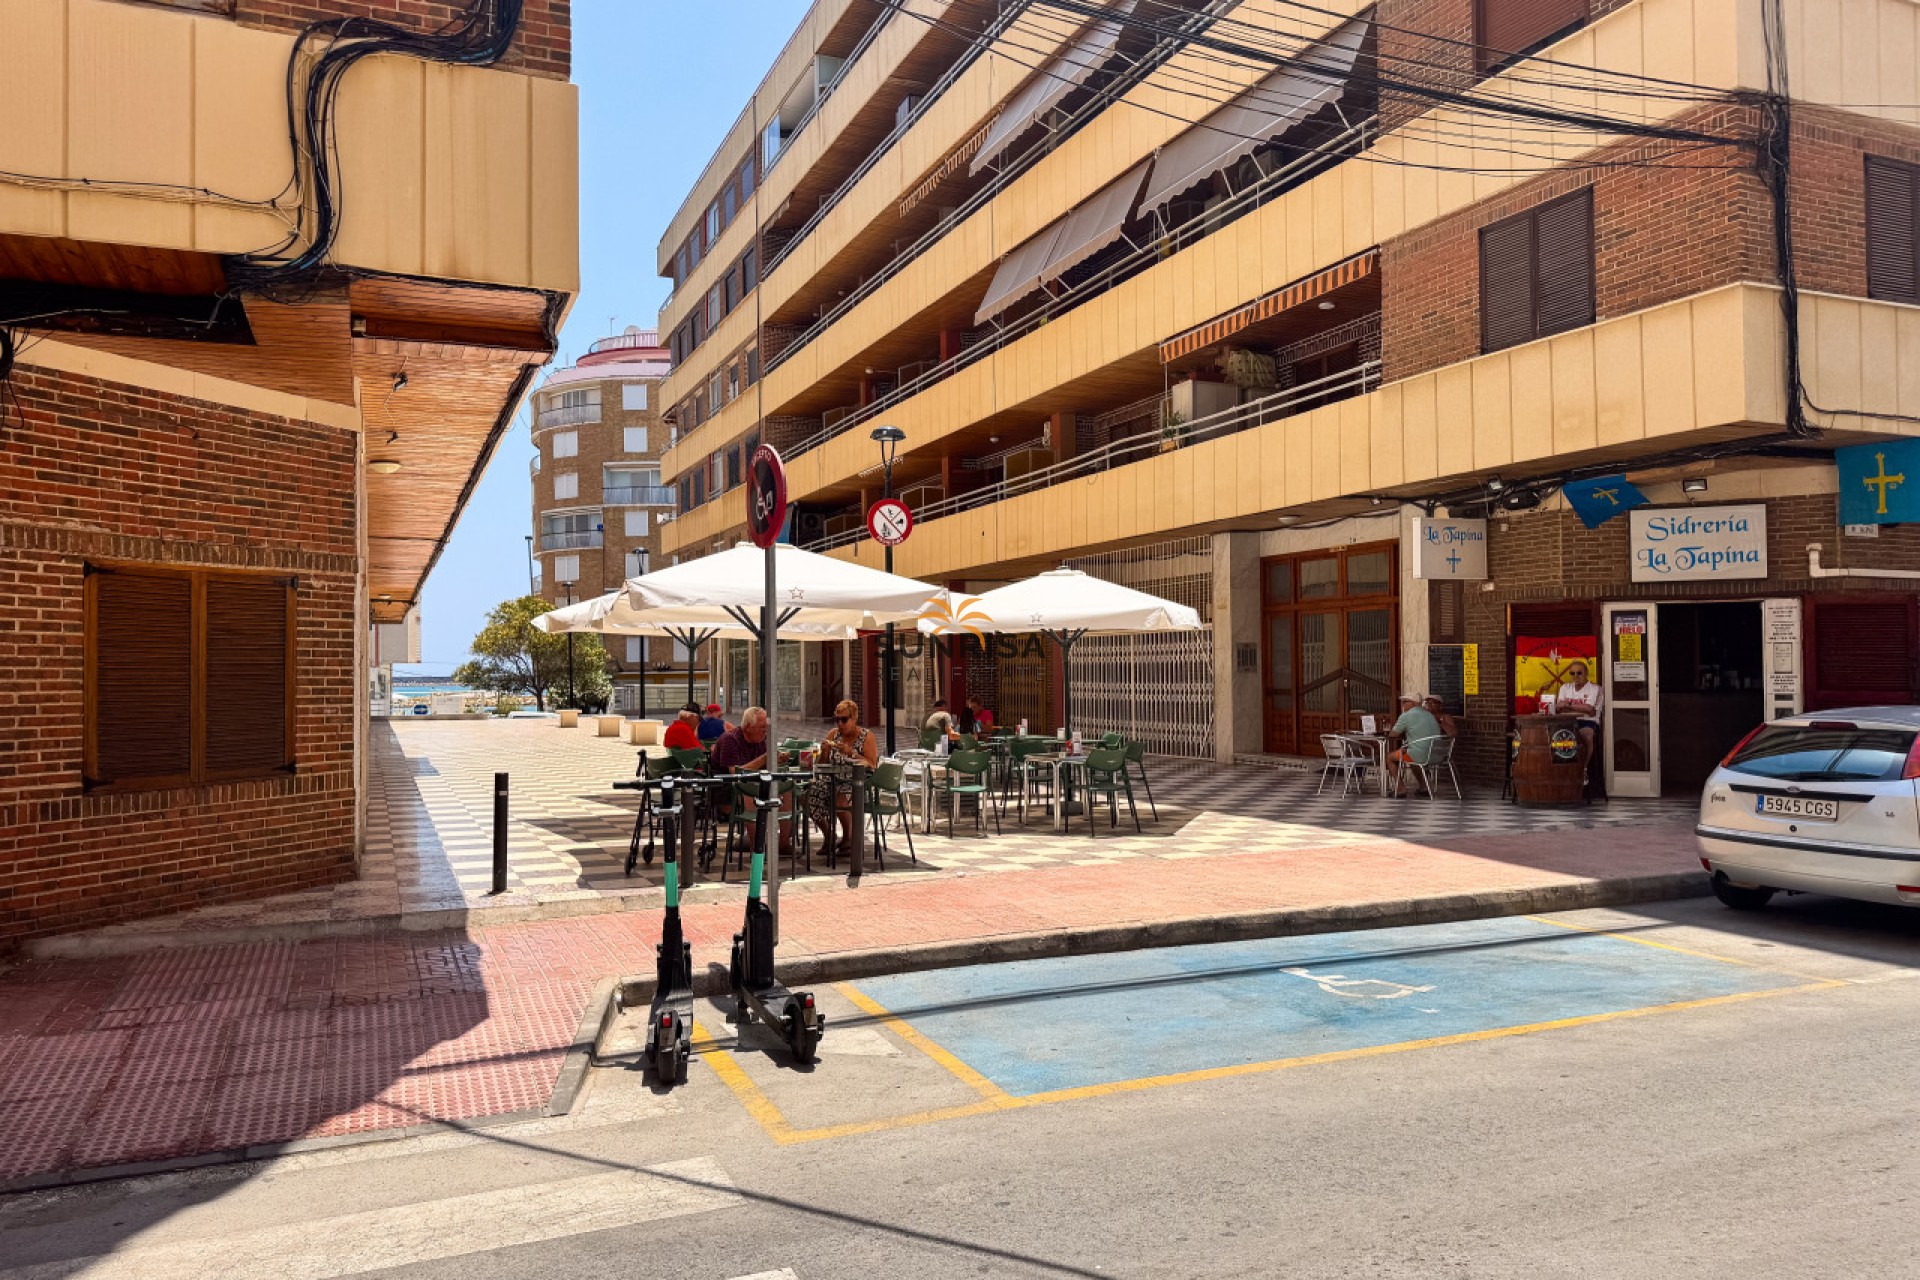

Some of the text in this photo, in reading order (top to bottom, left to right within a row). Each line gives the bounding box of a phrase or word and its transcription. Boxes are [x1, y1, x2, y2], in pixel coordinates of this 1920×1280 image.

[1422, 526, 1441, 545] La
[1646, 515, 1749, 541] Sidrería
[1637, 548, 1671, 573] La
[1766, 798, 1833, 816] 5945 CGS
